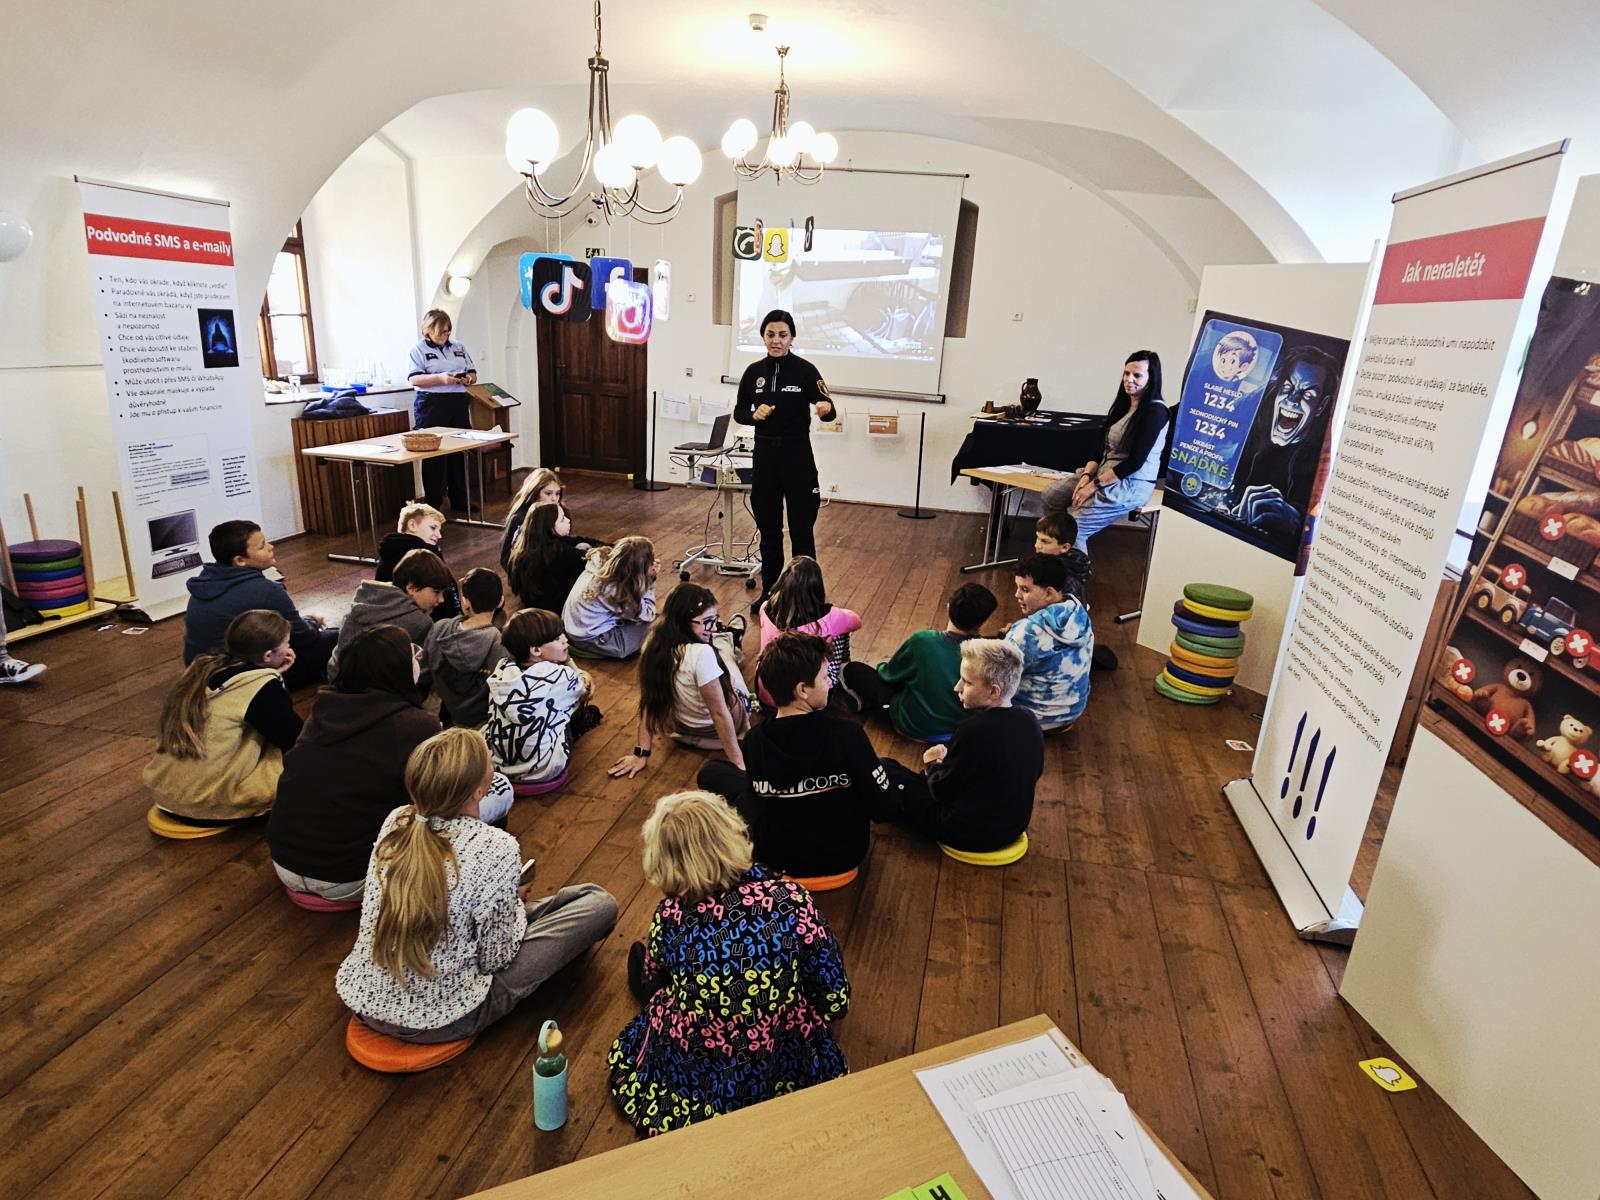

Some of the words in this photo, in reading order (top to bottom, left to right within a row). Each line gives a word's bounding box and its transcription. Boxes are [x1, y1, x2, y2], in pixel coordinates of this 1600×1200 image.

[87, 226, 151, 245] Podvodné
[154, 233, 180, 248] SMS
[183, 239, 190, 249] a
[192, 240, 230, 255] e-maily
[1401, 260, 1422, 283] Jak
[1423, 252, 1484, 280] nenaletět
[1460, 338, 1495, 350] napodobit
[1223, 389, 1242, 398] HESLO
[1448, 381, 1456, 391] za
[1456, 382, 1487, 397] bankéře,
[1203, 393, 1235, 412] 1234
[1189, 408, 1227, 424] JEDNODUCHÝ
[1228, 420, 1239, 429] PIN
[1409, 415, 1436, 431] informace
[1195, 419, 1226, 440] 1234
[1193, 439, 1215, 450] UKRÁST
[1204, 450, 1224, 462] PROFIL
[1428, 485, 1449, 499] osobě
[1414, 524, 1434, 540] zdrojů
[1390, 553, 1426, 579] internetového
[1399, 582, 1422, 600] e-mailu
